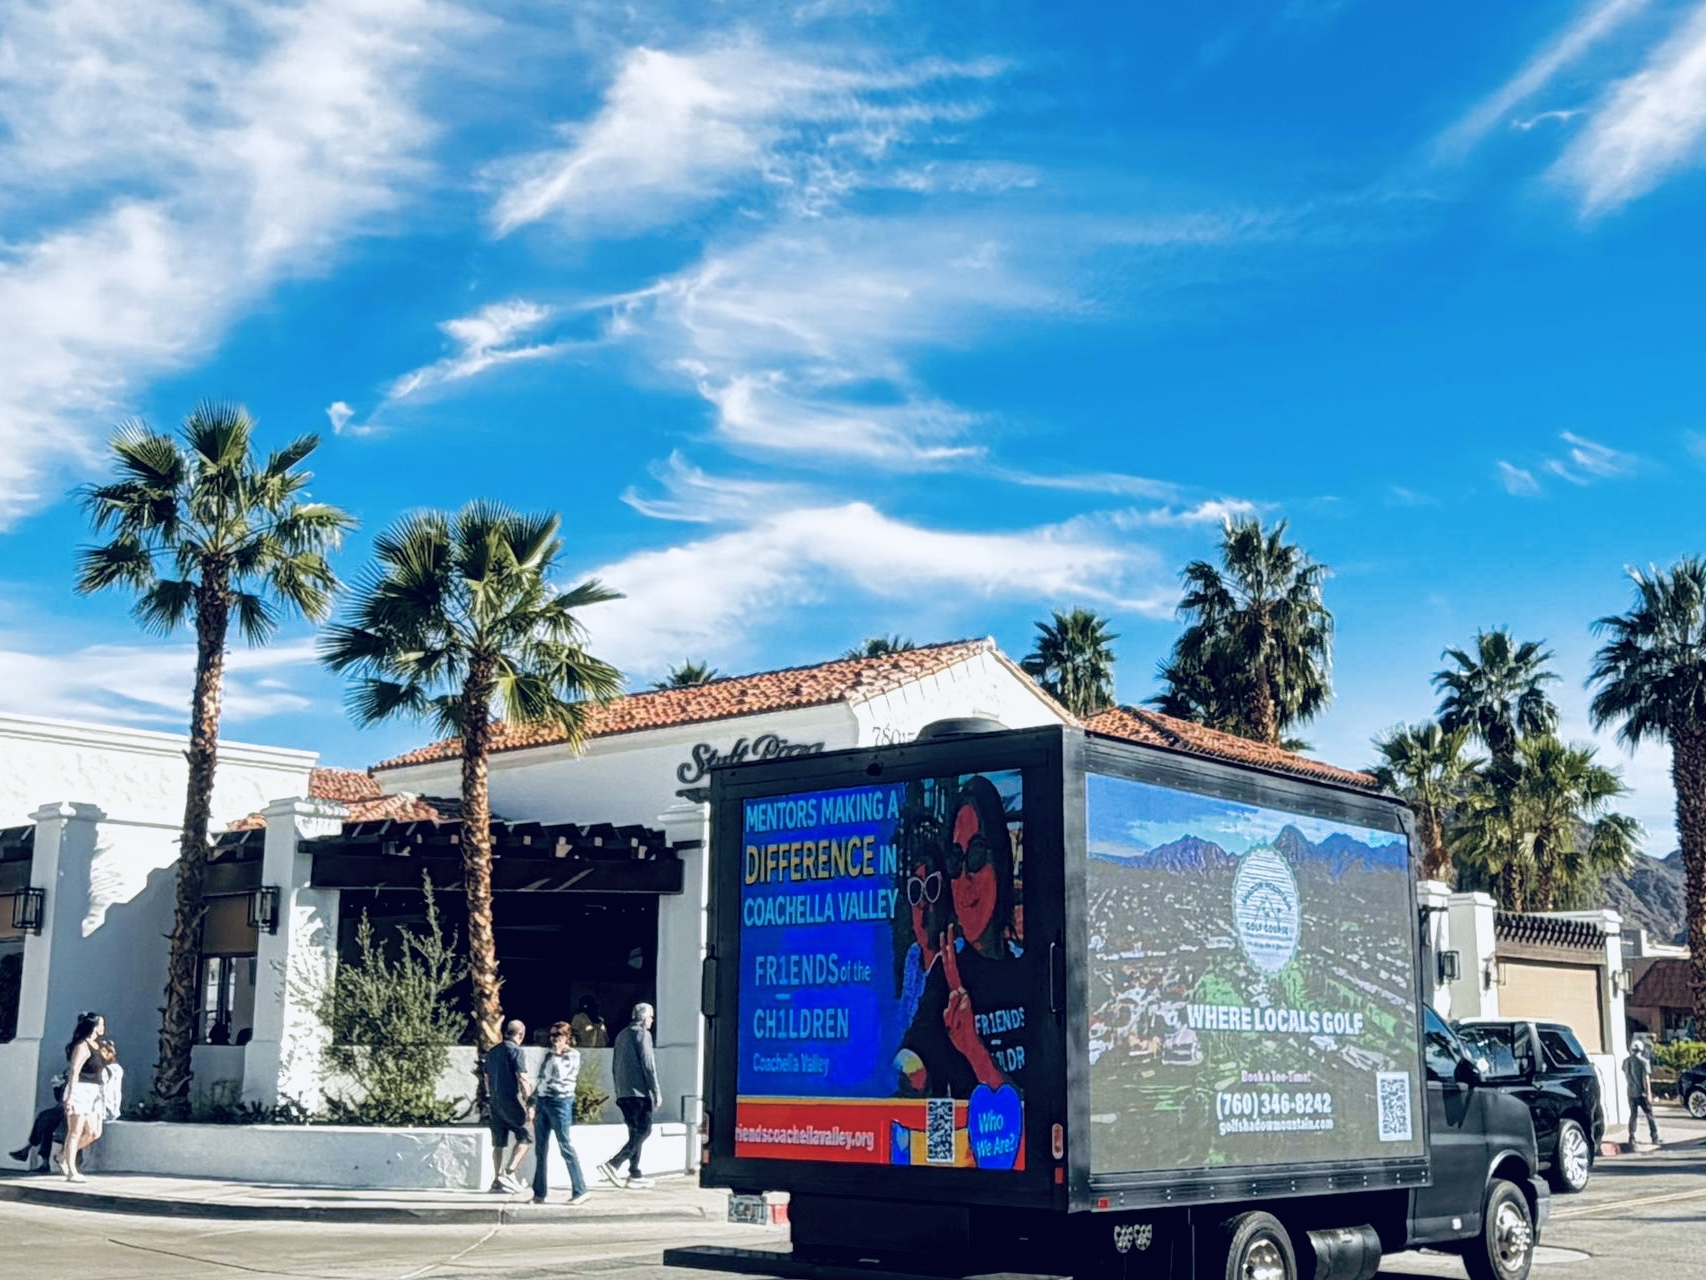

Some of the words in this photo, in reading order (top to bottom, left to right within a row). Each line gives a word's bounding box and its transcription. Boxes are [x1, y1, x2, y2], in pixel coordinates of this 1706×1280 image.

[746, 799, 817, 832] MENTORS
[821, 791, 884, 825] MAKING
[887, 790, 899, 819] A
[745, 835, 875, 885] DIFFERENCE
[879, 843, 897, 875] IN
[744, 893, 834, 926] COACHELLA
[838, 888, 899, 921] VALLEY
[840, 960, 851, 982] of
[853, 960, 871, 982] the
[1187, 1004, 1252, 1031] WHERE
[1254, 1007, 1321, 1034] LOCALS
[1322, 1011, 1363, 1035] GOLF
[1216, 1091, 1259, 1120] (760)
[1261, 1092, 1332, 1115] 346-8242
[978, 1109, 1004, 1134] Who
[977, 1139, 992, 1158] We
[994, 1133, 1016, 1156] Are?
